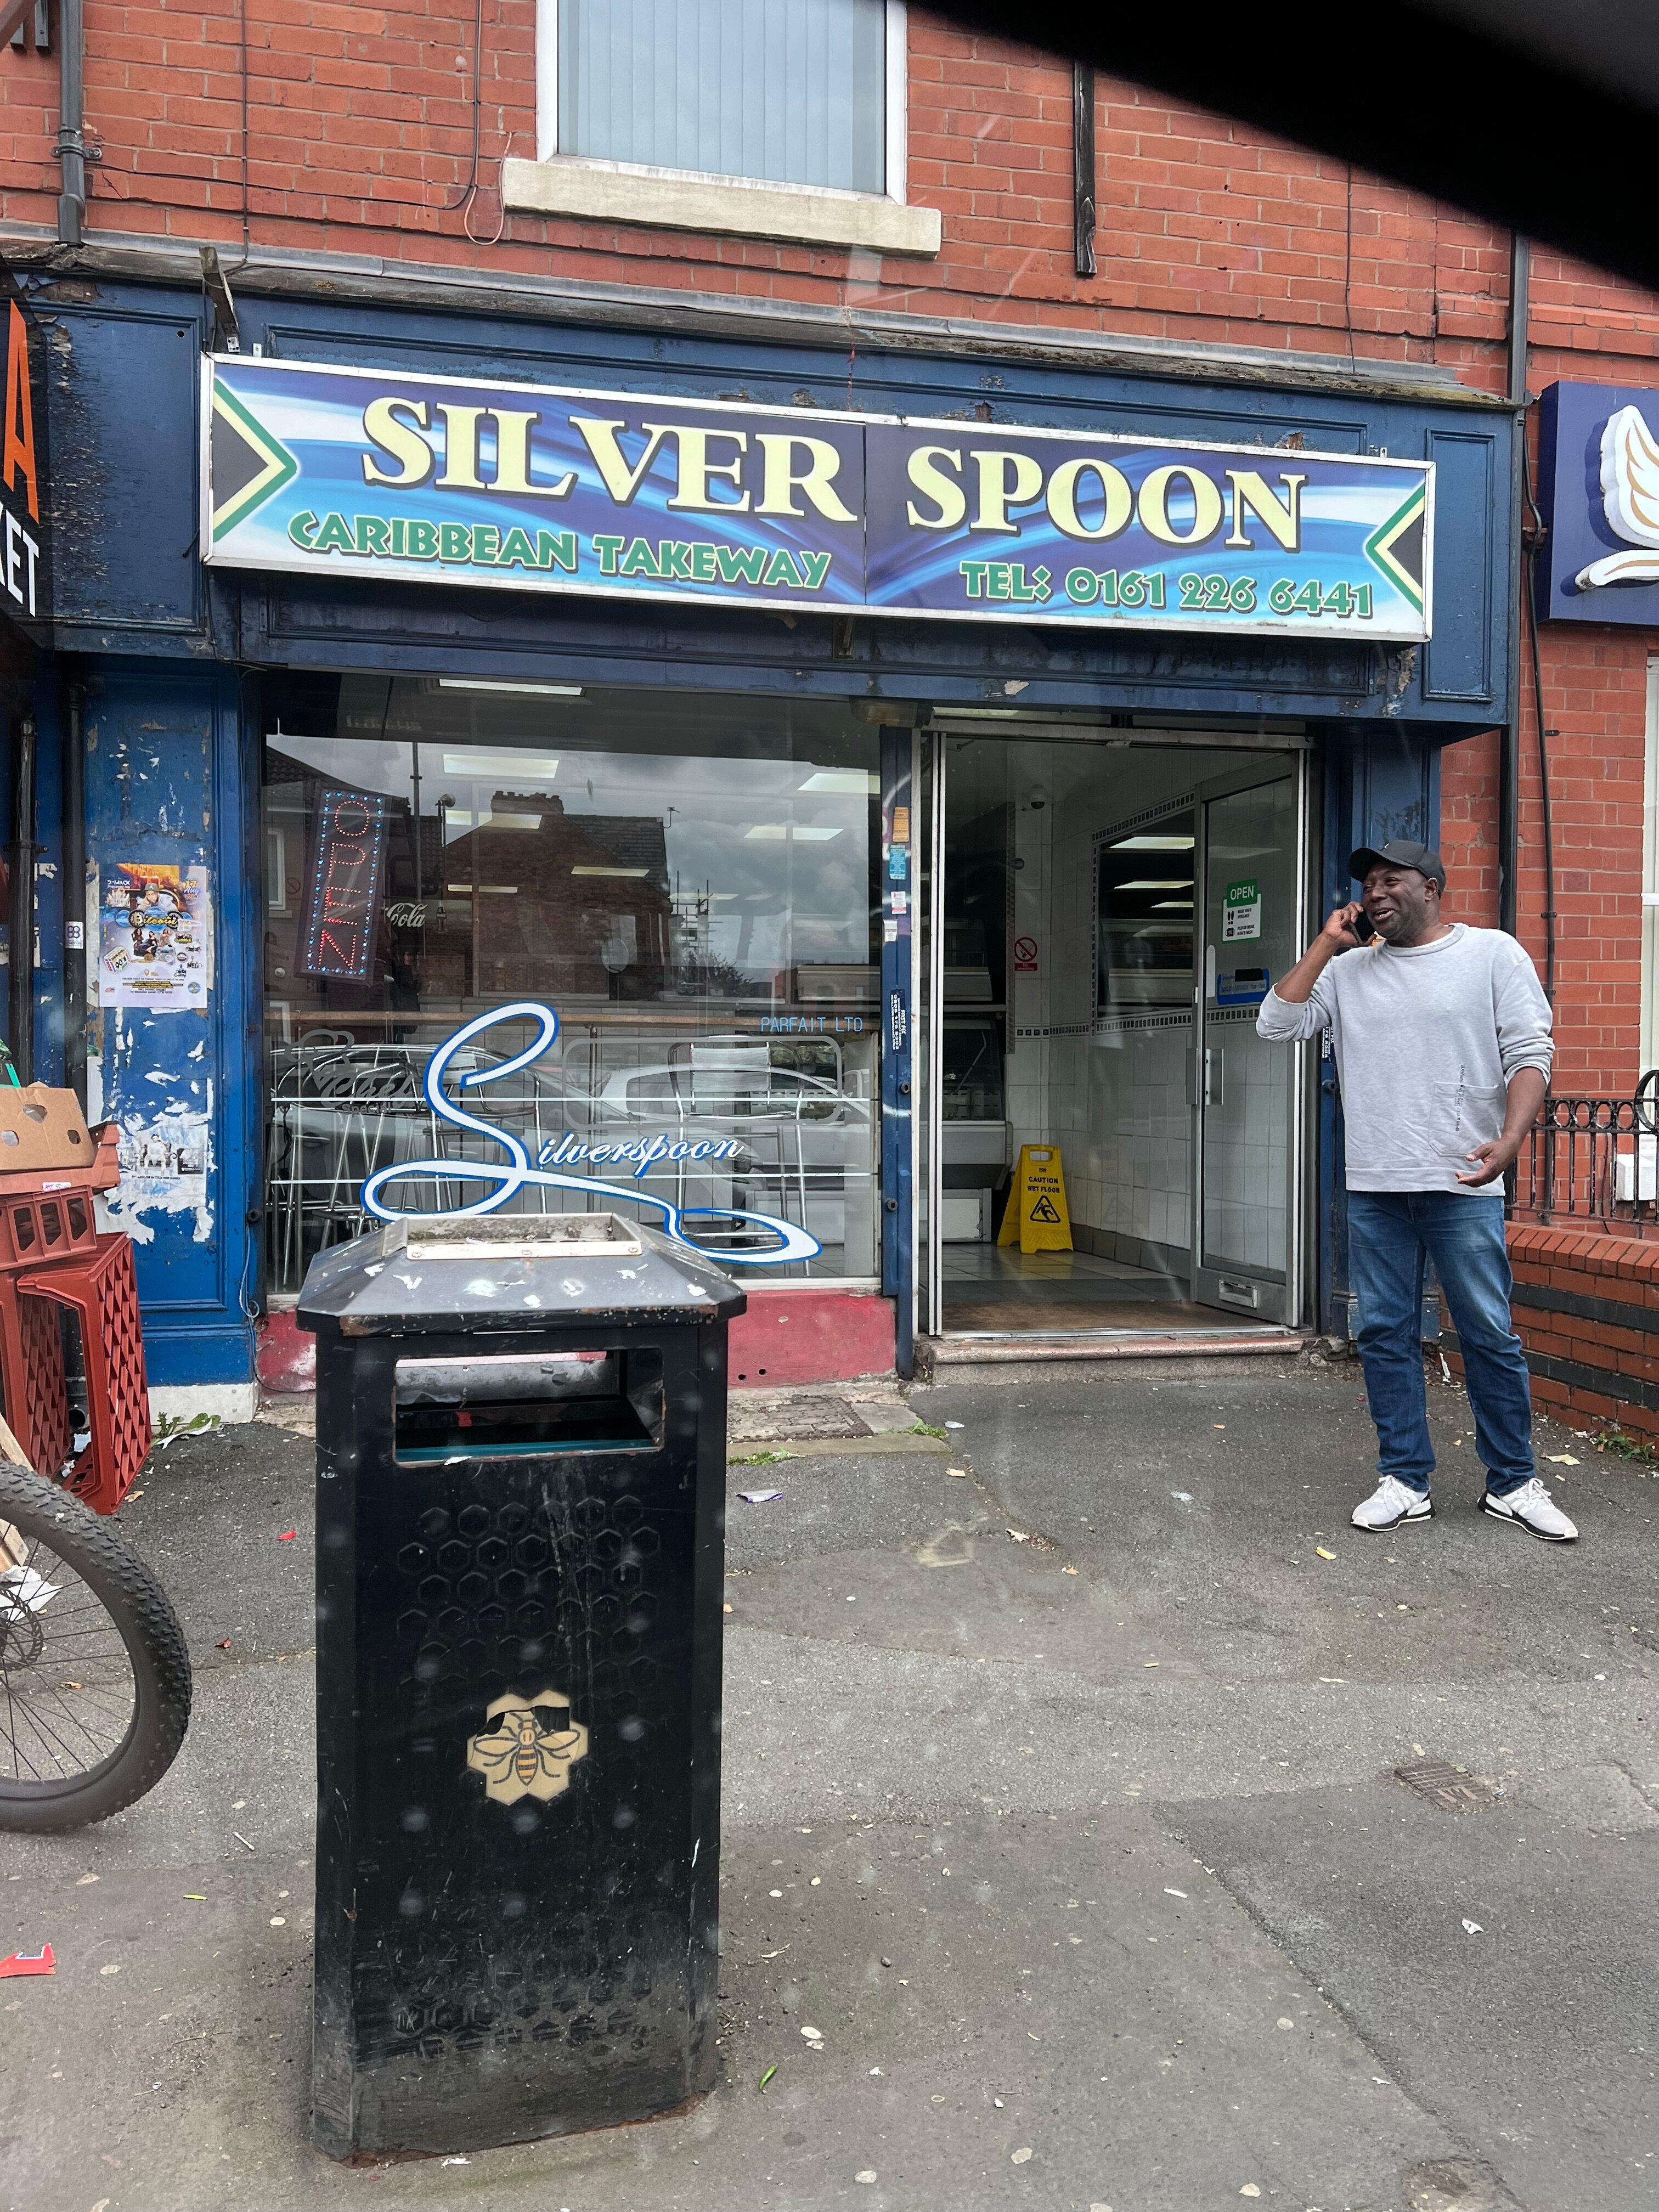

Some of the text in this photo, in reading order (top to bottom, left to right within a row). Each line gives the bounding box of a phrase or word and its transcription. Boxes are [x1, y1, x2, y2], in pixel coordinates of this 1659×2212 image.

[361, 396, 1306, 550] SILVER SPOON
[287, 510, 832, 590] CARIBBEAN TAKEWAY
[959, 560, 1373, 618] TEL: 0161 226 6441
[184, 887, 200, 895] Aug
[185, 880, 198, 888] 17
[318, 800, 370, 969] OPEN
[1230, 885, 1254, 900] OPEN
[761, 1017, 863, 1032] PARFAIT LTD
[360, 1002, 823, 1265] Silverspoon
